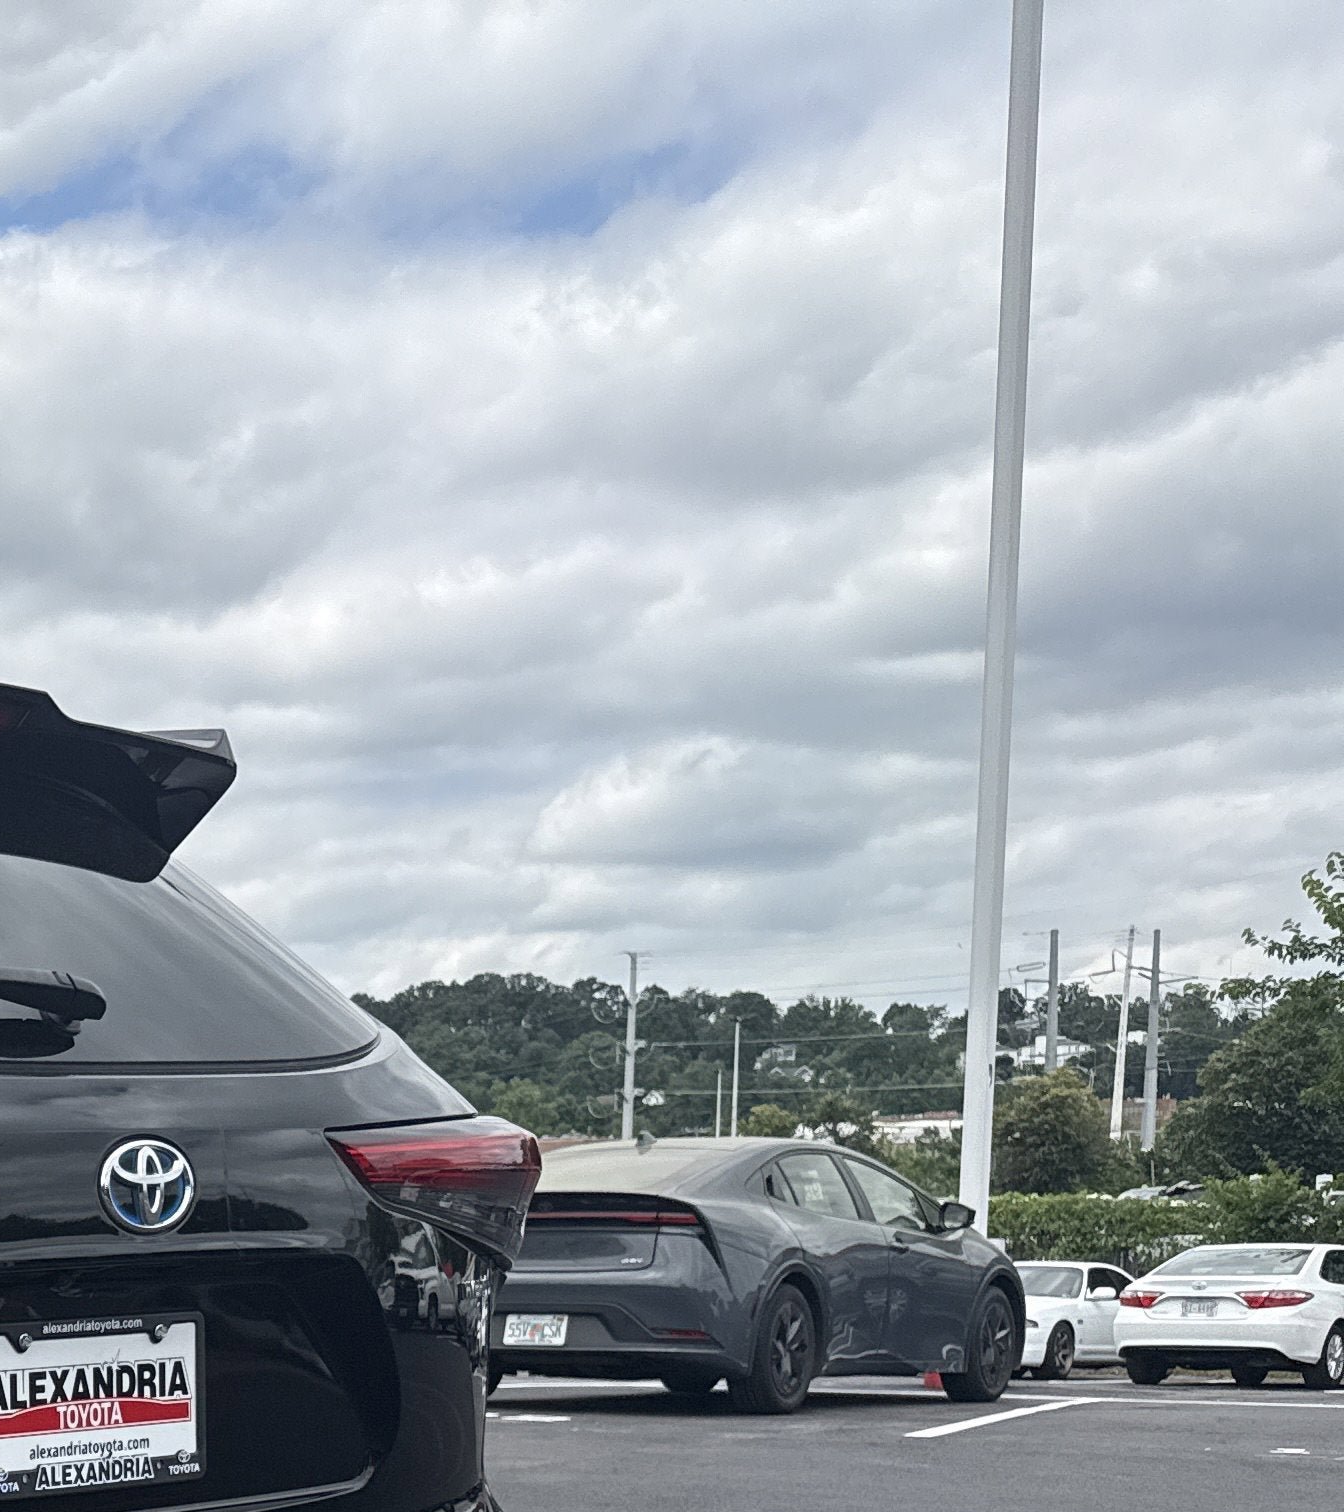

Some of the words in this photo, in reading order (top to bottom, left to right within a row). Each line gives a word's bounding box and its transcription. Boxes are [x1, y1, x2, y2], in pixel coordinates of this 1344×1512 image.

[42, 1317, 143, 1335] alexandriatoyota.com
[56, 1402, 124, 1430] TOYOTA
[36, 1455, 154, 1490] ALEXANDRIA
[168, 1463, 201, 1476] TOYOTA
